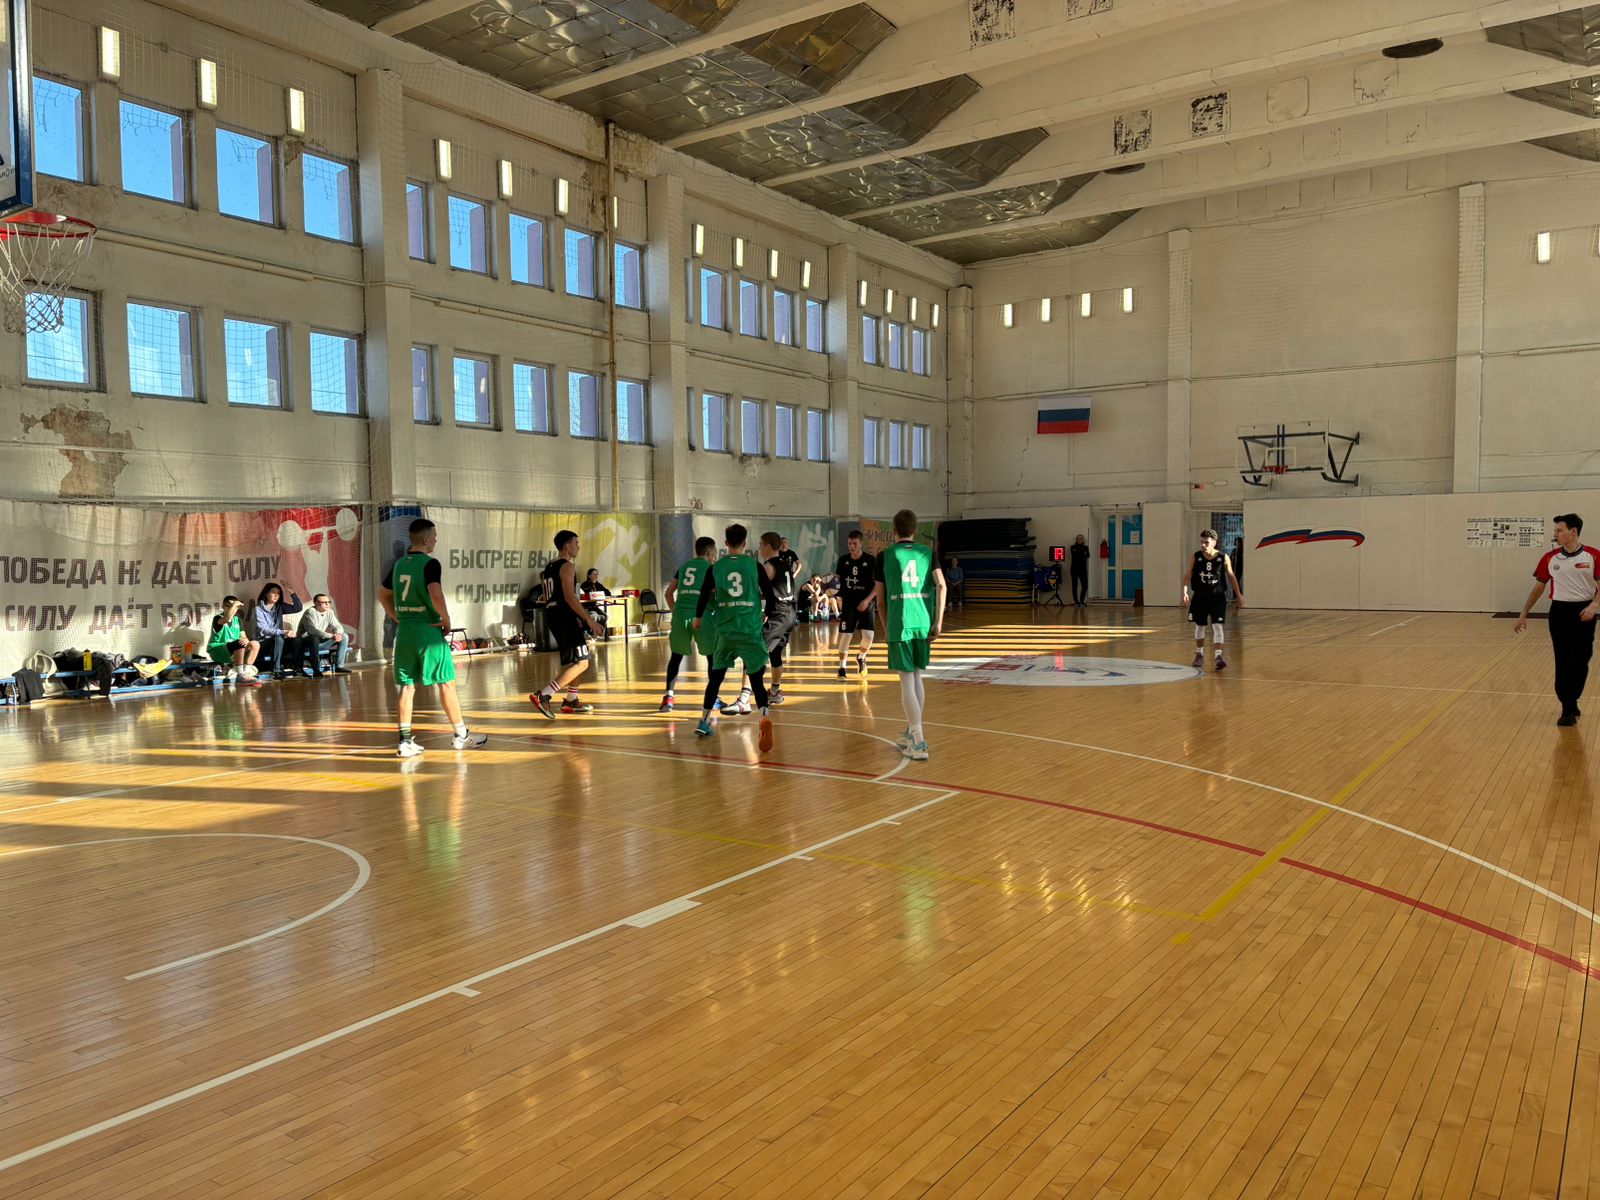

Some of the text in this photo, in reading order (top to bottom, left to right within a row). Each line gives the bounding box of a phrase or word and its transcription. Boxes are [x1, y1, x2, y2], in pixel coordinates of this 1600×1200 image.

[118, 560, 142, 585] НЕ
[152, 554, 217, 588] ДАЁТ
[228, 555, 281, 583] СИЛУ
[683, 567, 697, 586] 5
[852, 566, 859, 576] 6
[902, 559, 920, 588] 4
[1206, 561, 1212, 571] 8
[400, 574, 411, 601] 7
[727, 571, 743, 597] 3
[784, 570, 792, 594] 1
[5, 604, 77, 632] СИЛУ
[88, 597, 154, 634] ДАЁТ
[576, 644, 589, 657] 10
